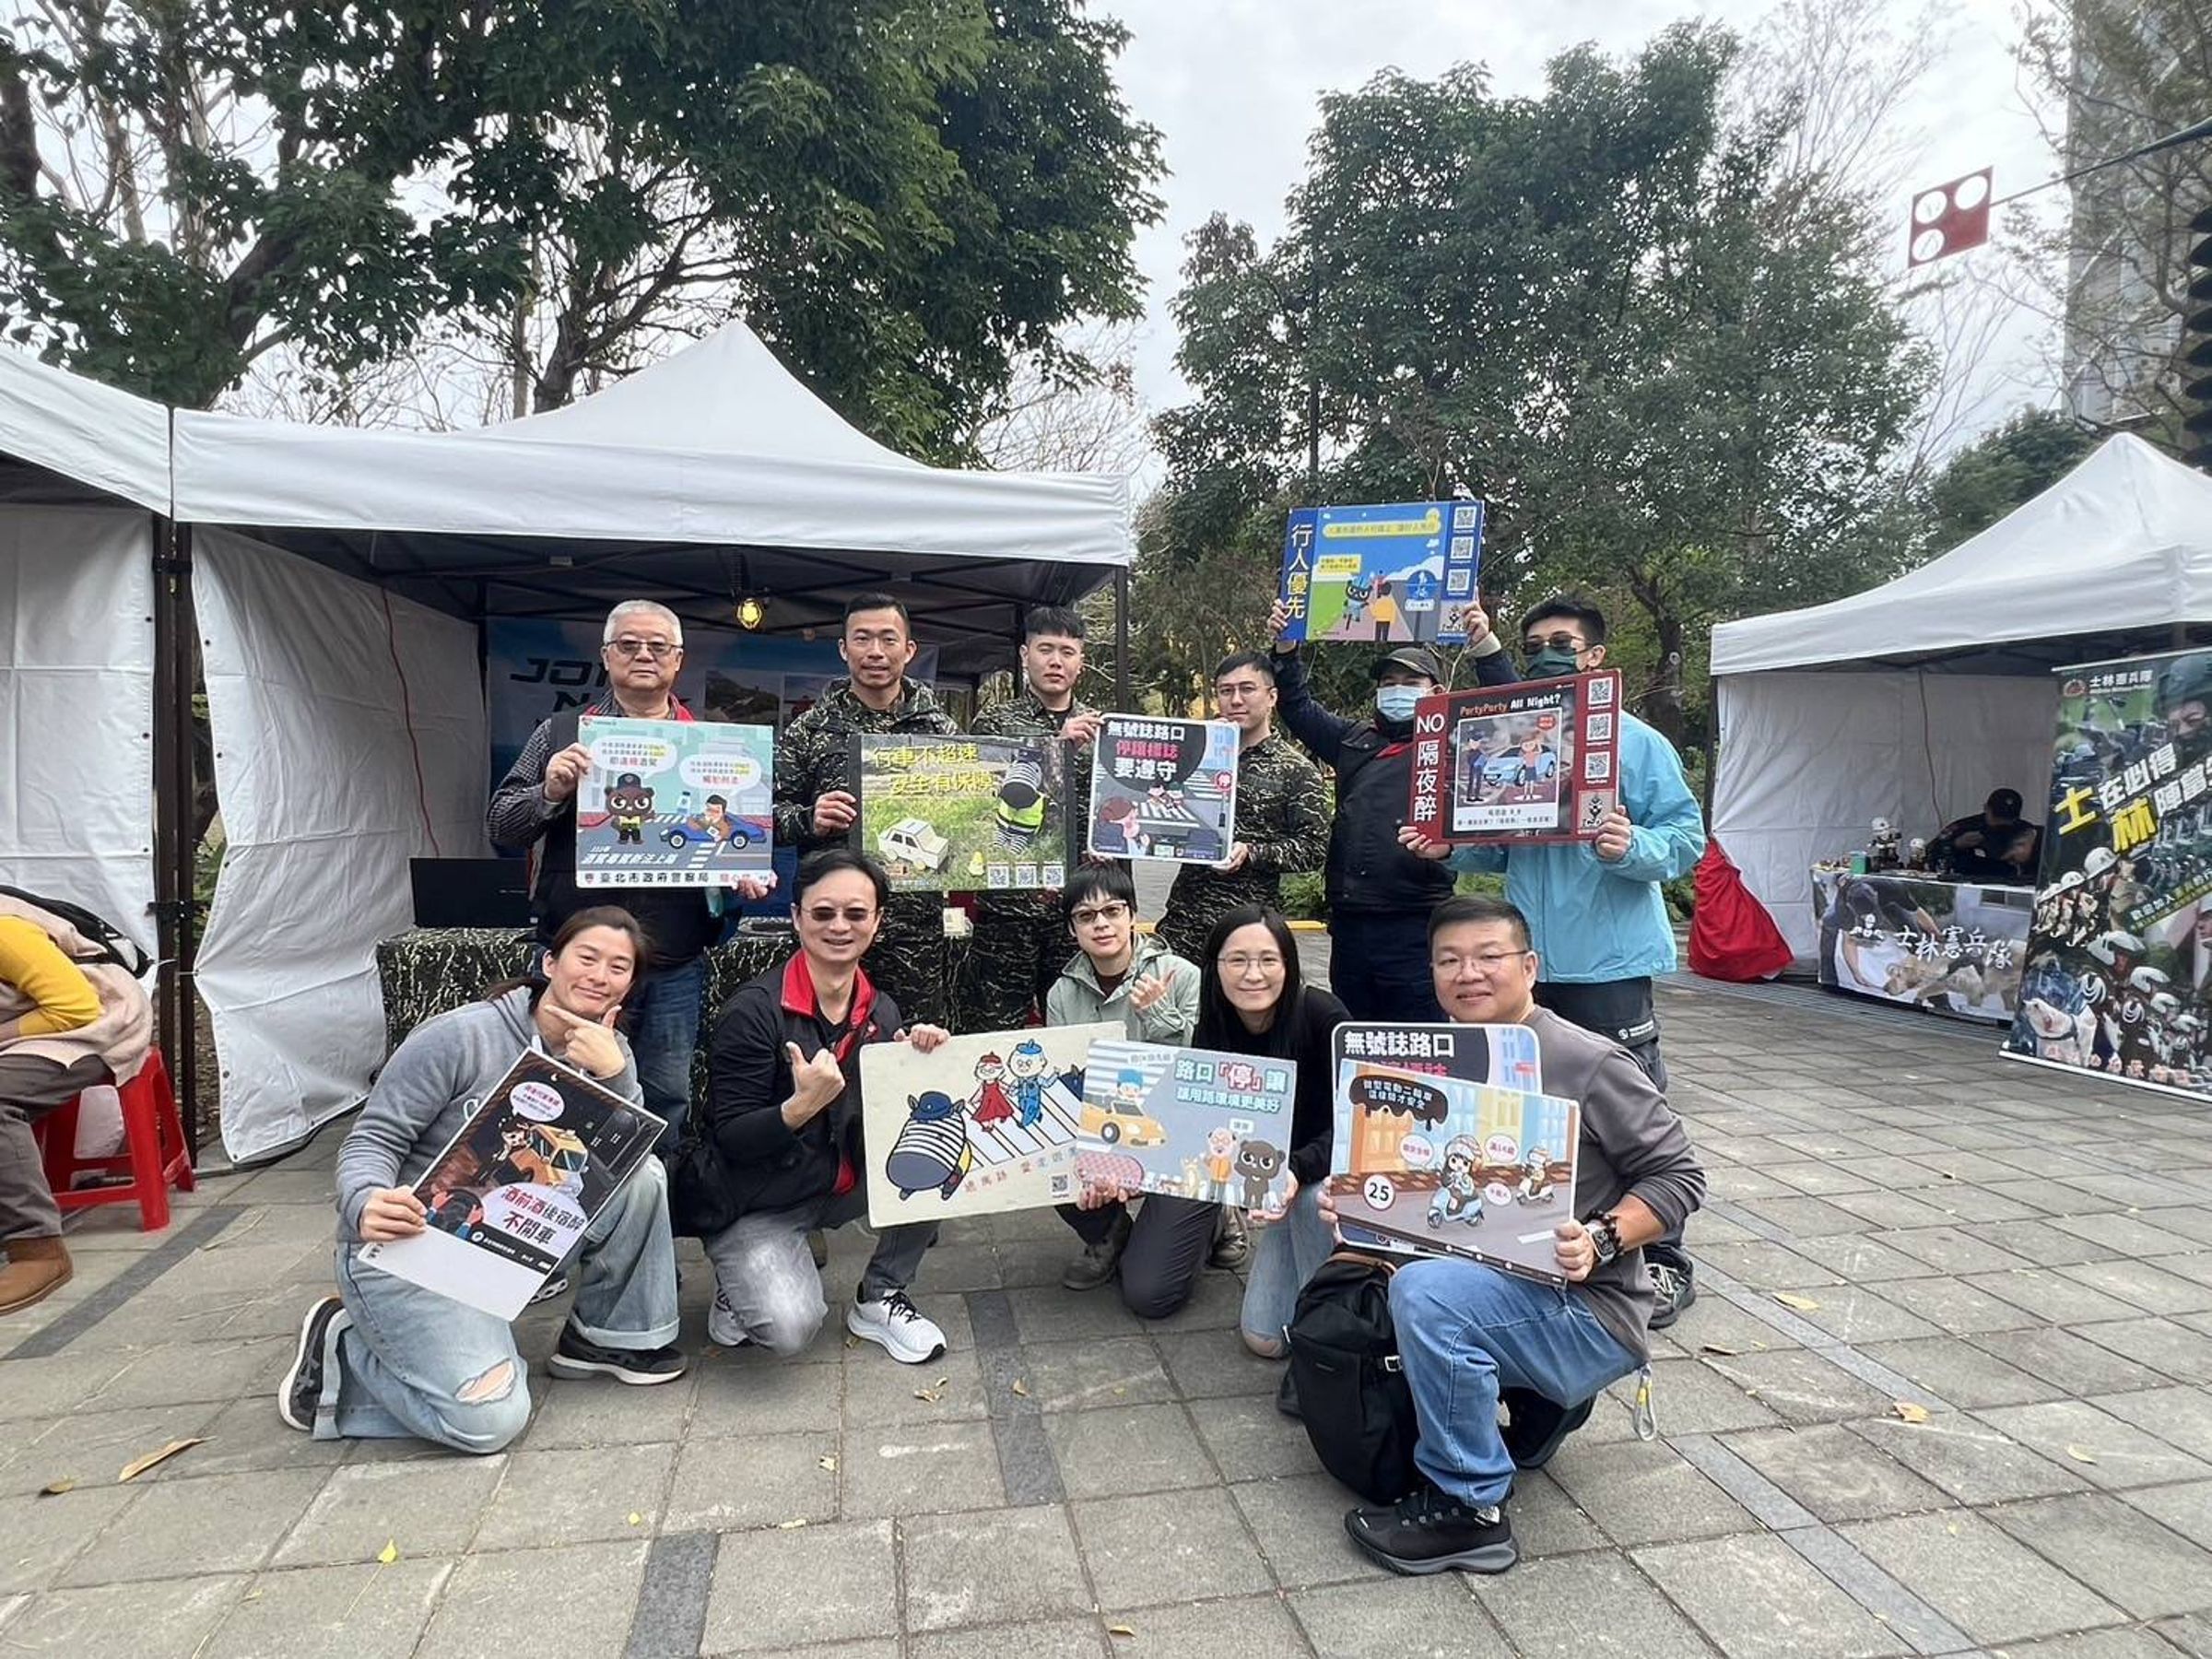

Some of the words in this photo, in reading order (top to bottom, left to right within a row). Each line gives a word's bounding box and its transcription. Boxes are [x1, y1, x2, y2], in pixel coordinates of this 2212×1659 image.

[1284, 524, 1312, 619] 行人優先
[1510, 699, 1524, 711] All
[1526, 693, 1561, 709] Night?
[1107, 721, 1185, 741] 無號誌路口
[1416, 713, 1445, 735] NO
[873, 743, 980, 768] 行車不超速
[1113, 758, 1177, 782] 要遵守
[1414, 739, 1440, 821] 隔夜醉
[890, 771, 994, 794] 安全有保障
[1894, 924, 2013, 969] 士林憲兵隊
[1344, 1030, 1455, 1058] 無號誌路口
[1368, 1182, 1390, 1201] 25
[503, 1210, 557, 1244] 不開車
